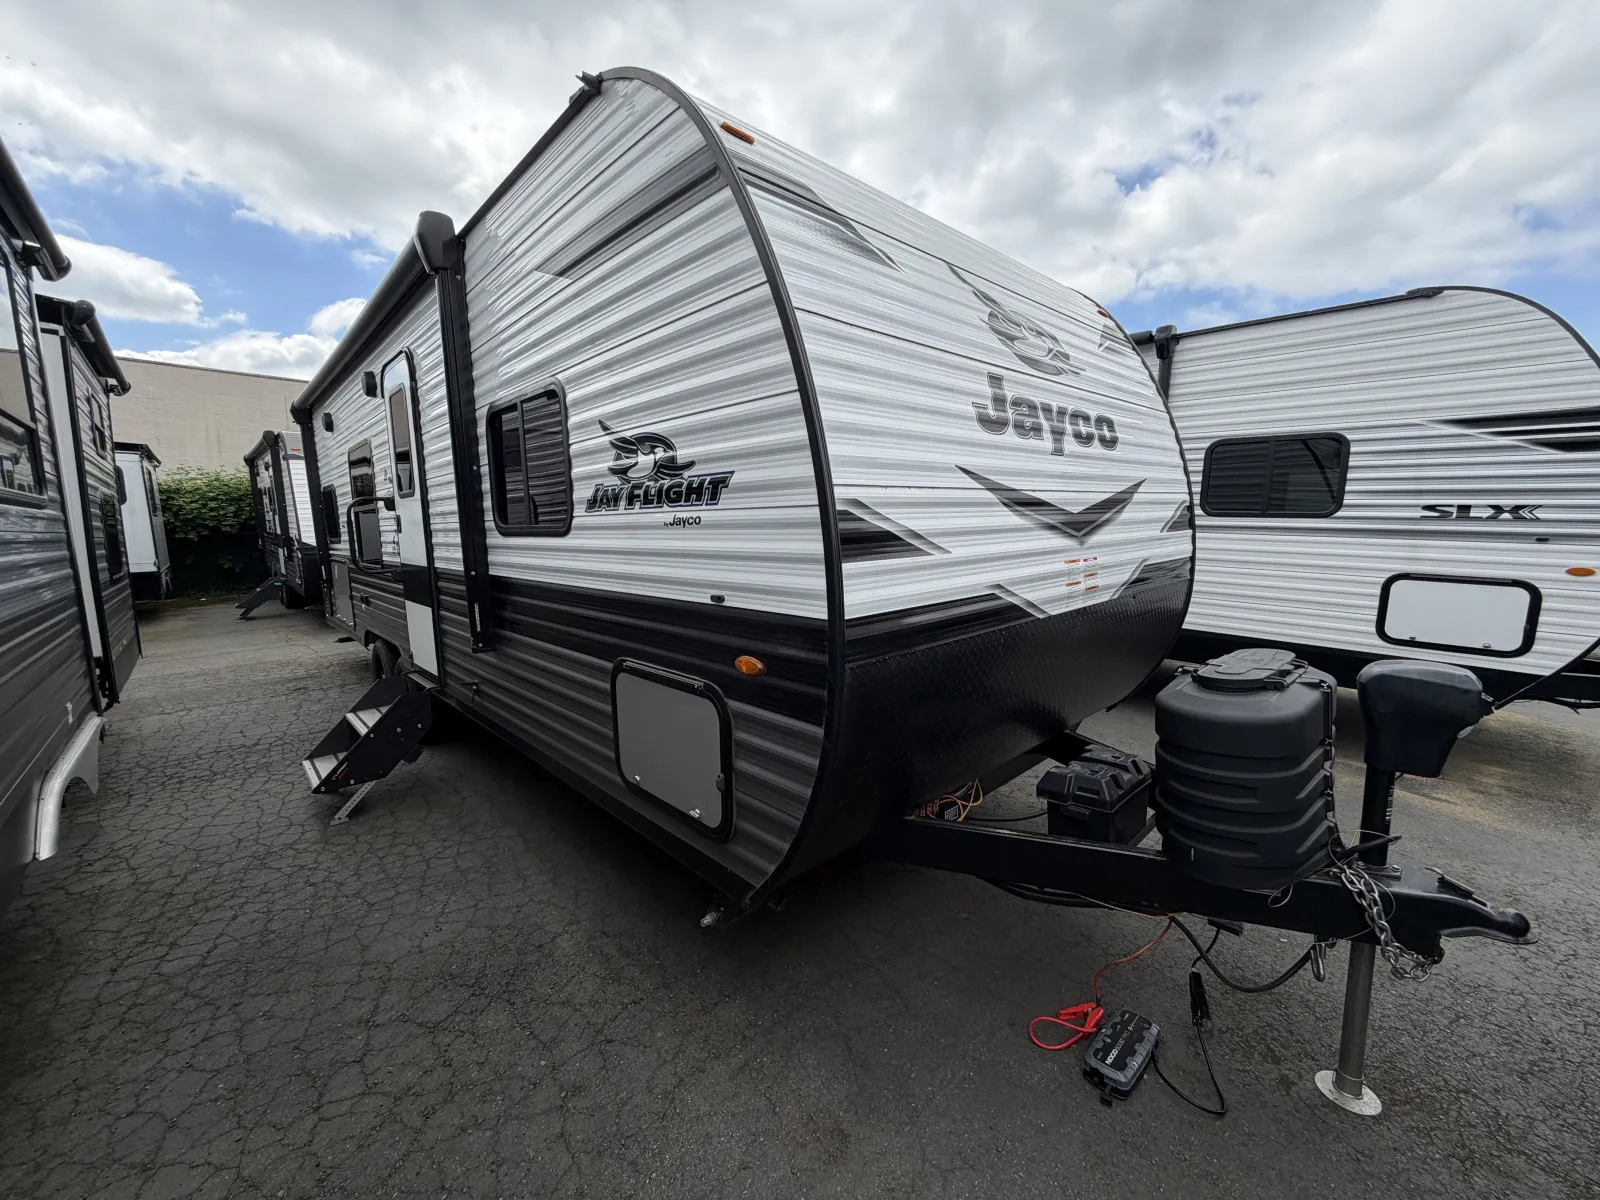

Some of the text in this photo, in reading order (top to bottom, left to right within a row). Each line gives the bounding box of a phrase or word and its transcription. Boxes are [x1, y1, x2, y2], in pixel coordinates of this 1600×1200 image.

[972, 372, 1120, 456] Jayco
[585, 471, 735, 513] JAY FLIGHT
[1420, 504, 1543, 520] SLX
[669, 514, 702, 528] Jayco
[1105, 1048, 1118, 1065] NOCO
